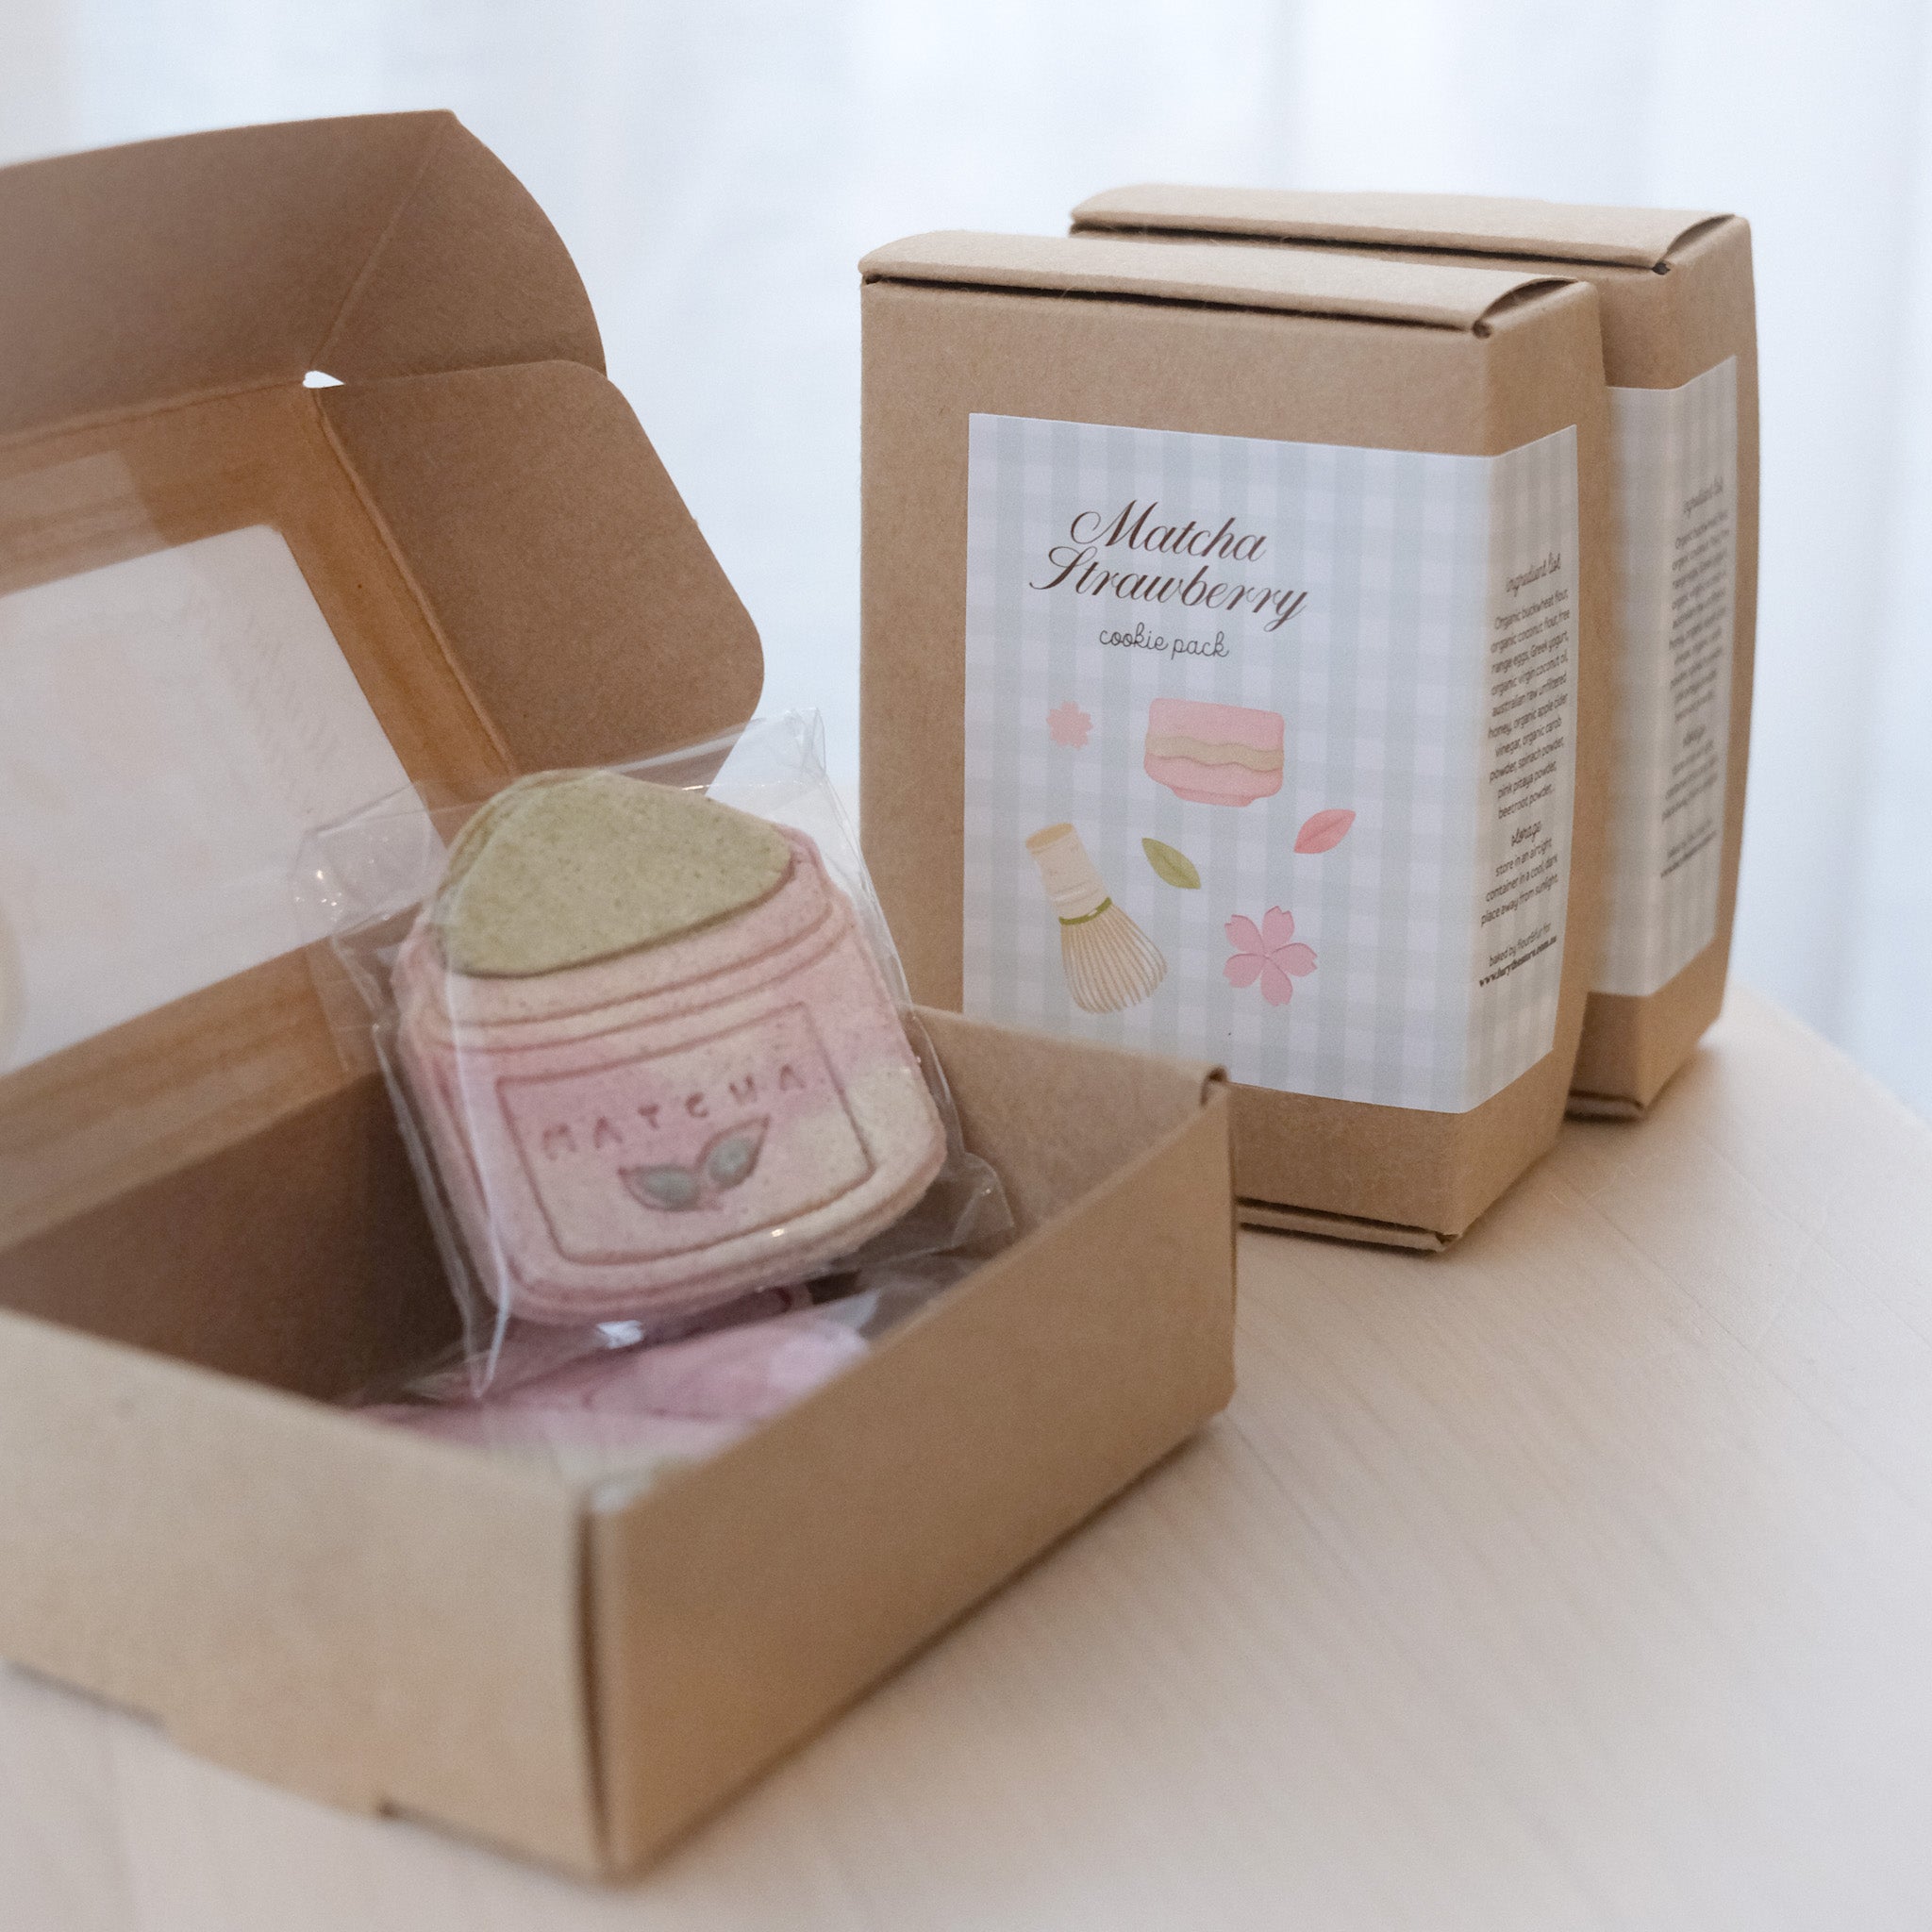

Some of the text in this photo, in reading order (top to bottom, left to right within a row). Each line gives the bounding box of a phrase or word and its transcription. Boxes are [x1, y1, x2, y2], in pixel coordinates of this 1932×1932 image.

[1070, 500, 1268, 562] Matcha
[1029, 545, 1309, 632] Strawberry
[1494, 612, 1521, 630] Organic
[1522, 594, 1554, 618] buckwheat
[1099, 623, 1230, 659] cookie pack
[1491, 632, 1517, 654] organic
[1517, 623, 1543, 641] coconut
[1491, 658, 1512, 674] range
[1530, 640, 1548, 658] Greek
[1491, 675, 1517, 696] organic
[1518, 666, 1535, 684] virgin
[1536, 657, 1559, 676] coconut
[1513, 708, 1537, 729] organic
[1537, 699, 1554, 718] apple
[1554, 693, 1568, 709] cider
[1526, 691, 1538, 701] raw
[1523, 724, 1544, 745] organic
[1545, 715, 1562, 733] carob
[1518, 749, 1541, 769] spinach
[1497, 783, 1512, 799] pink
[1513, 774, 1533, 794] pitaya
[1498, 796, 1528, 819] beetroot
[1496, 837, 1552, 877] store in an airtight
[1486, 877, 1519, 902] container
[1481, 908, 1501, 927] place
[1501, 898, 1518, 915] away
[1518, 889, 1535, 905] from
[1490, 945, 1508, 967] baked
[1508, 945, 1516, 958] by
